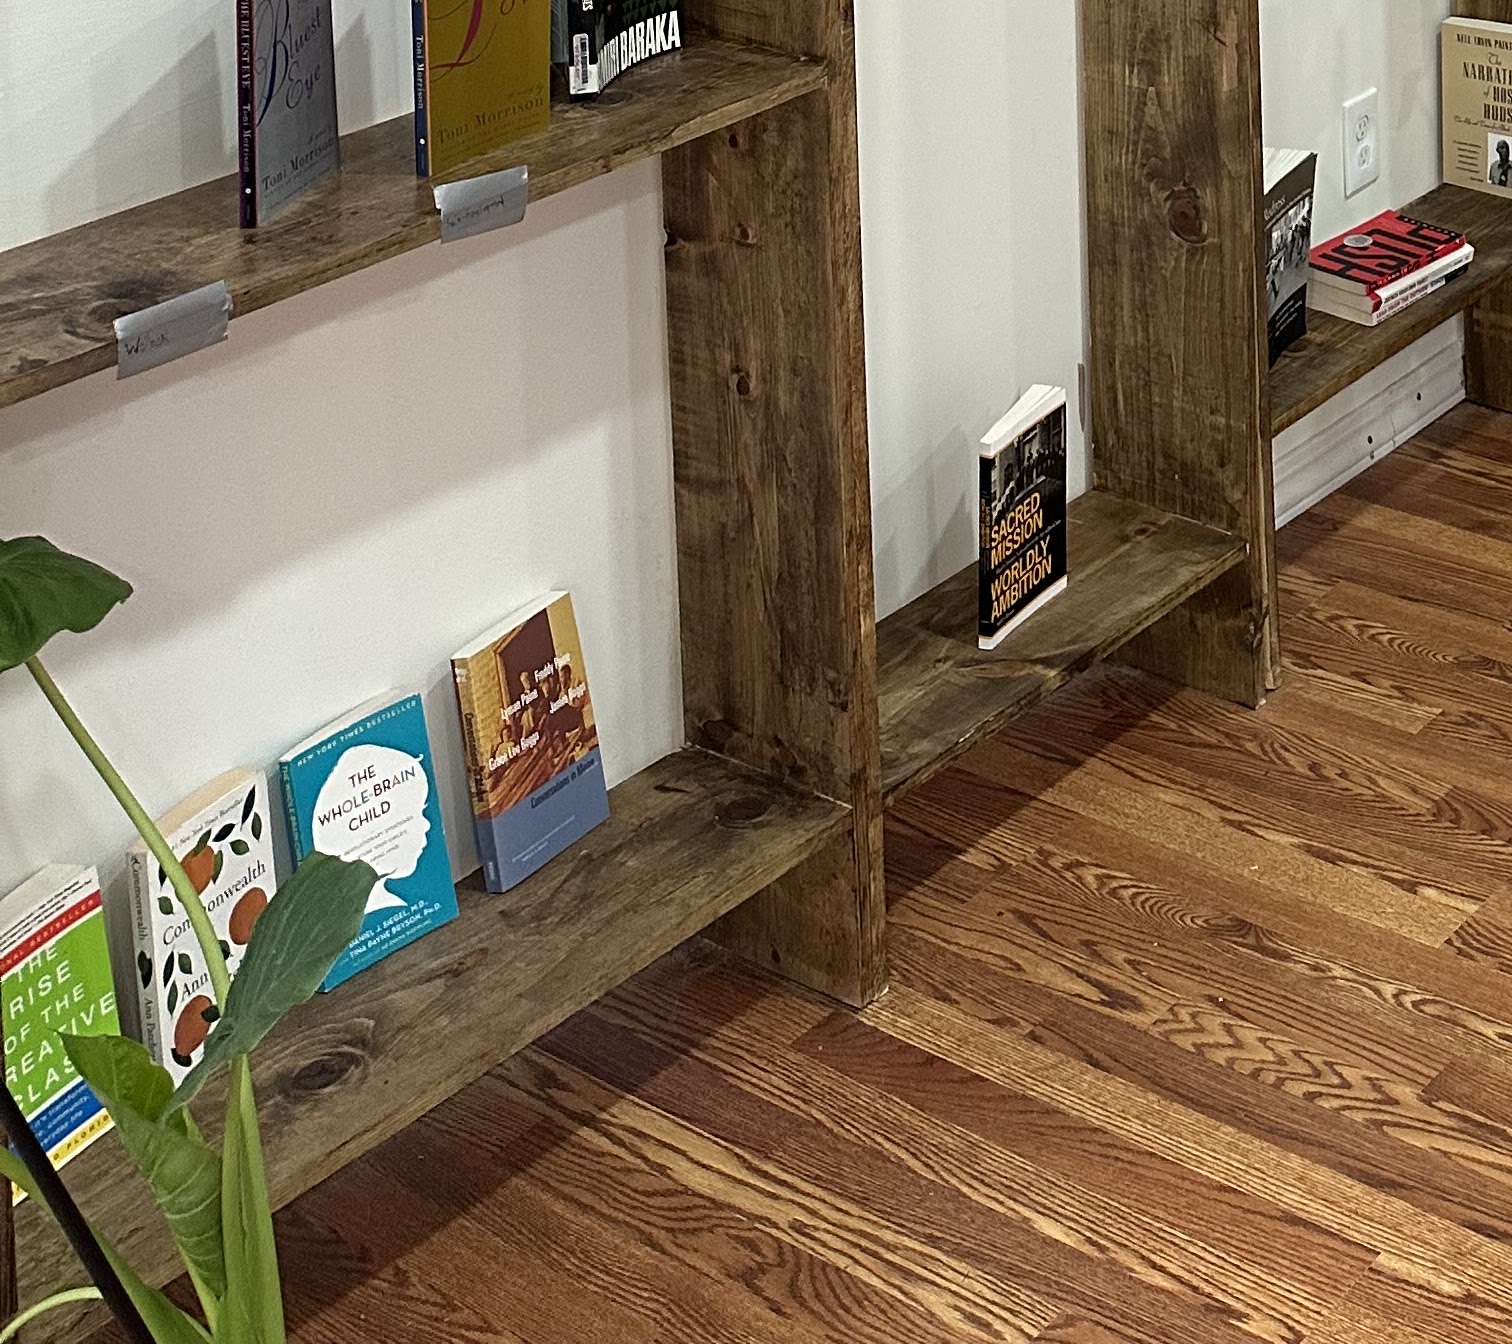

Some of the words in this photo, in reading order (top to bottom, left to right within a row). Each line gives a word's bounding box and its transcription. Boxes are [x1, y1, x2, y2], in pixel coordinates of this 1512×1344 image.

[241, 20, 251, 64] BLUEST
[415, 35, 424, 55] Toni
[620, 9, 681, 71] BARAKA
[1456, 33, 1471, 45] NELL
[1474, 37, 1492, 48] IRVIN
[286, 61, 321, 109] Eye
[416, 62, 425, 110] Morrison
[438, 125, 470, 145] Toni
[474, 97, 544, 128] Morrison
[262, 168, 287, 192] Toni
[290, 136, 334, 173] Morrison
[991, 492, 1040, 547] SACRED
[991, 508, 1043, 570] MISSION
[991, 534, 1050, 601] WORLDLY
[991, 554, 1052, 624] AMBITION
[520, 688, 539, 707] Paine
[550, 695, 569, 715] James
[297, 753, 315, 768] NEW
[316, 741, 338, 757] YORK
[339, 725, 365, 744] TIMES
[366, 700, 417, 730] BESTSELLER
[488, 752, 509, 772] Grace
[521, 730, 540, 751] Boggs
[317, 765, 416, 827] WHOLE-BRAIN
[347, 763, 377, 789] THE
[530, 775, 570, 810] Conversations
[347, 800, 392, 832] CHILD
[29, 898, 94, 948] BESTSELLER
[133, 858, 149, 941] Commonwealth
[15, 943, 58, 984] THE
[349, 943, 367, 960] TINA
[367, 931, 390, 951] PAYNE
[9, 960, 72, 1021] RISE
[4, 1022, 31, 1056] OF
[40, 982, 85, 1024] THE
